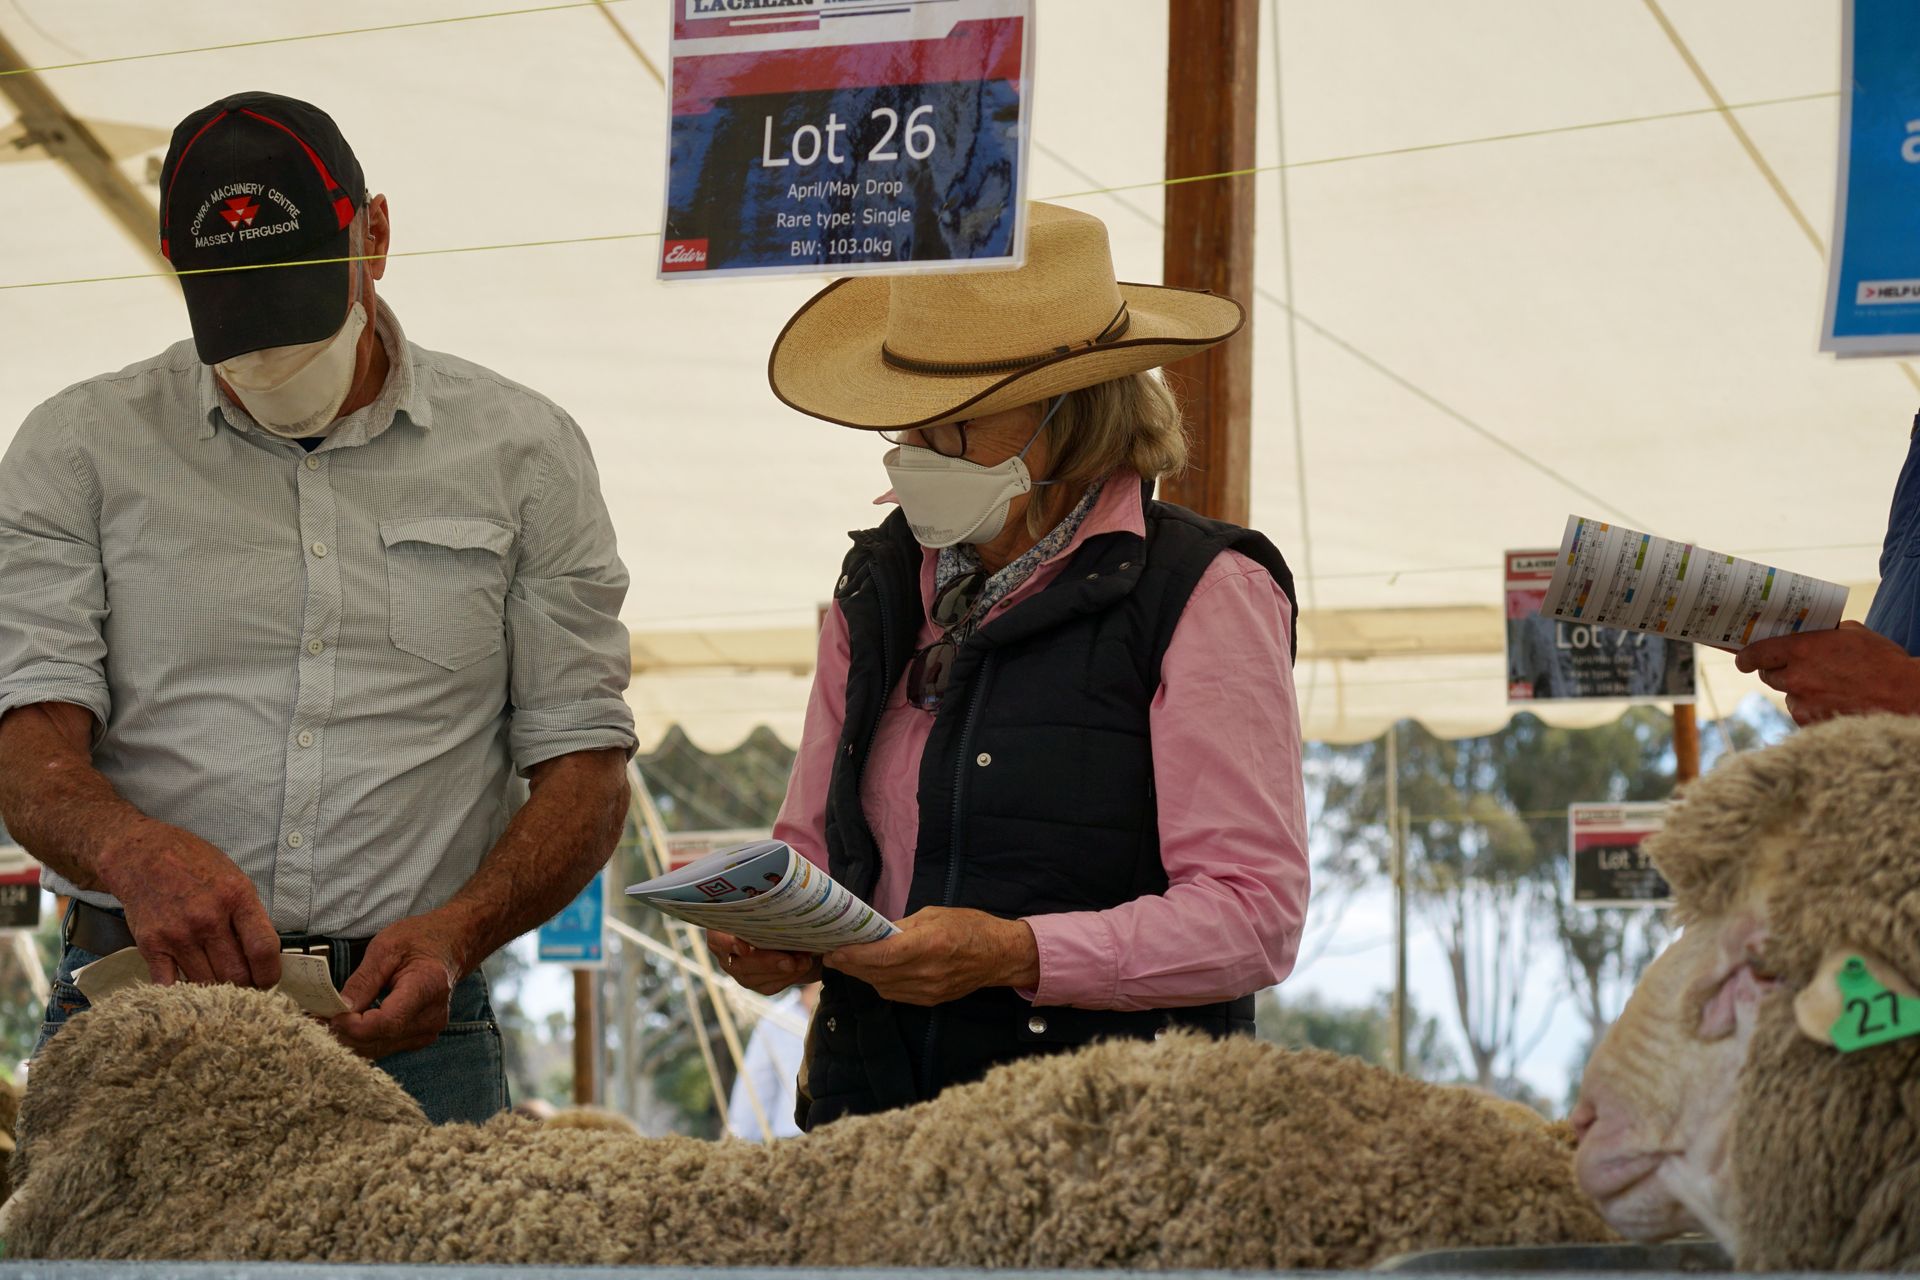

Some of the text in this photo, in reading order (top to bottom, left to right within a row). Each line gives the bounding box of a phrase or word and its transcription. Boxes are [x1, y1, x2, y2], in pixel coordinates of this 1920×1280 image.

[762, 105, 937, 168] Lot 26
[786, 179, 903, 201] April/May Drop
[190, 183, 300, 236] COWRA MACHINERY CENTRE
[776, 206, 911, 229] Rare type: Single
[195, 219, 300, 249] MASSEY FERGUSON
[665, 245, 707, 263] Elders
[790, 237, 893, 257] BW: 103.0kg
[1878, 286, 1910, 298] HELP
[1556, 623, 1602, 649] Lot
[1598, 848, 1630, 870] Lot
[1846, 990, 1900, 1037] 27
